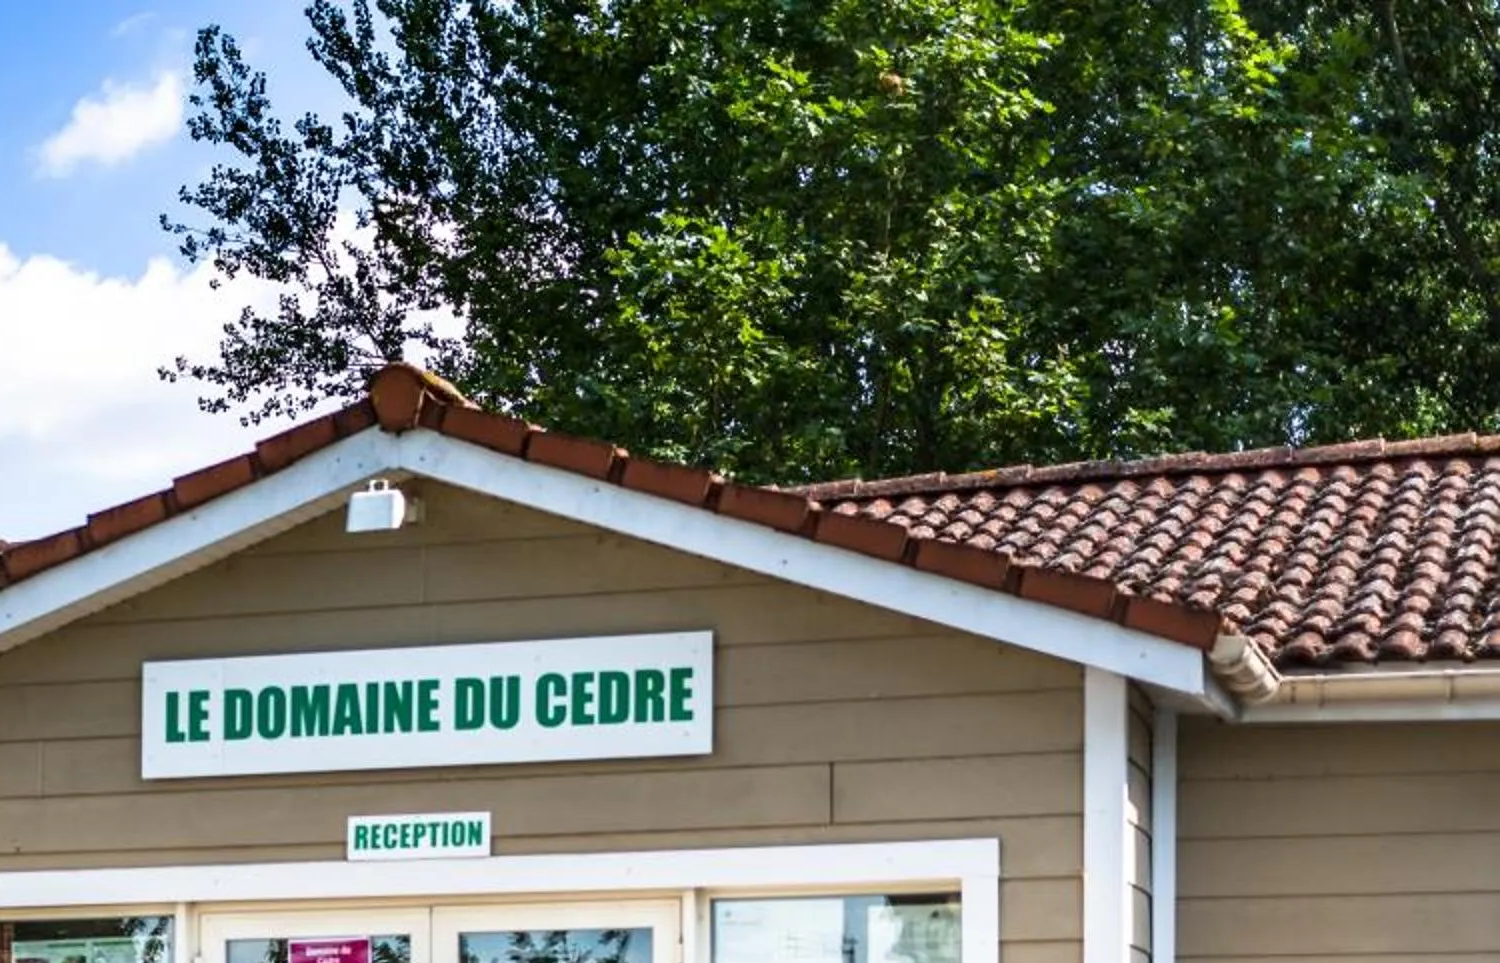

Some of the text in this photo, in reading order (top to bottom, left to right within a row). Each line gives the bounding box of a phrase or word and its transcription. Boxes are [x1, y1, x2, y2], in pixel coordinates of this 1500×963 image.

[165, 666, 695, 744] LE DOMAINE DU CEDRE
[354, 820, 484, 851] RECEPTION
